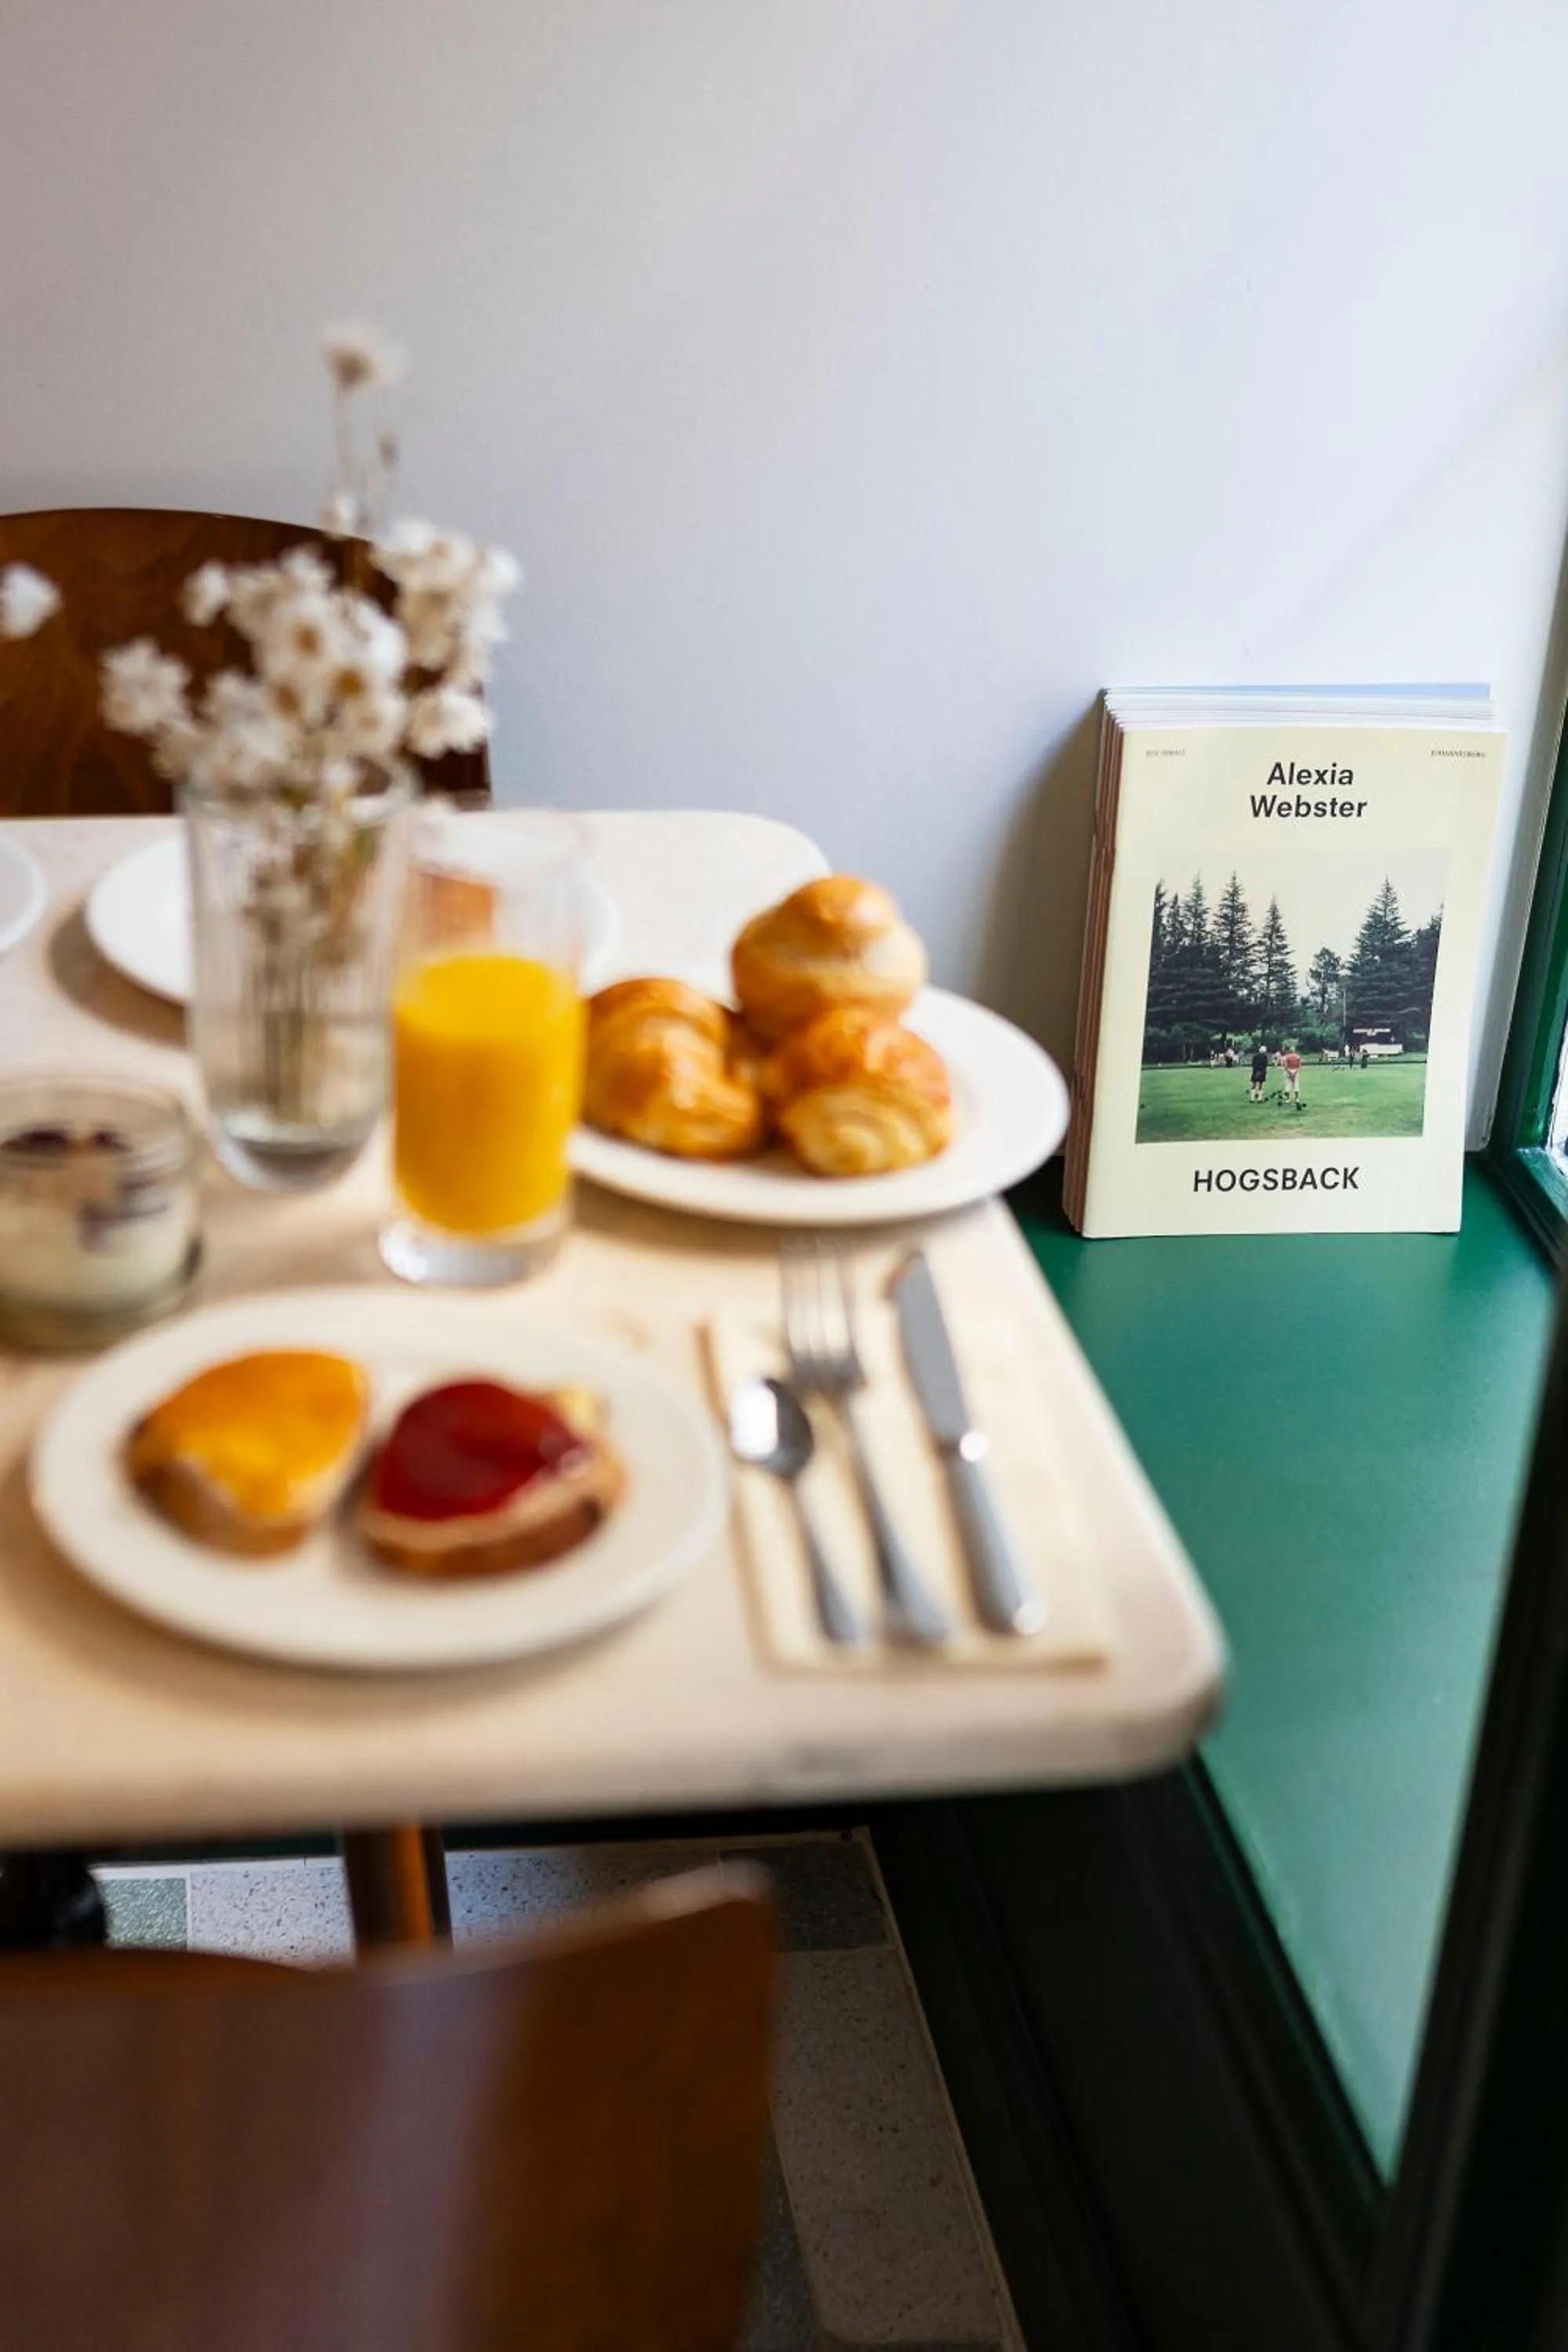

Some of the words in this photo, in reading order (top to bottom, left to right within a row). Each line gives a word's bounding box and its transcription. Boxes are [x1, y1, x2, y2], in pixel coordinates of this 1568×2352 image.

[1266, 761, 1354, 786] Alexia
[1250, 794, 1368, 818] Webster
[1192, 1167, 1359, 1193] HOGSBACK
